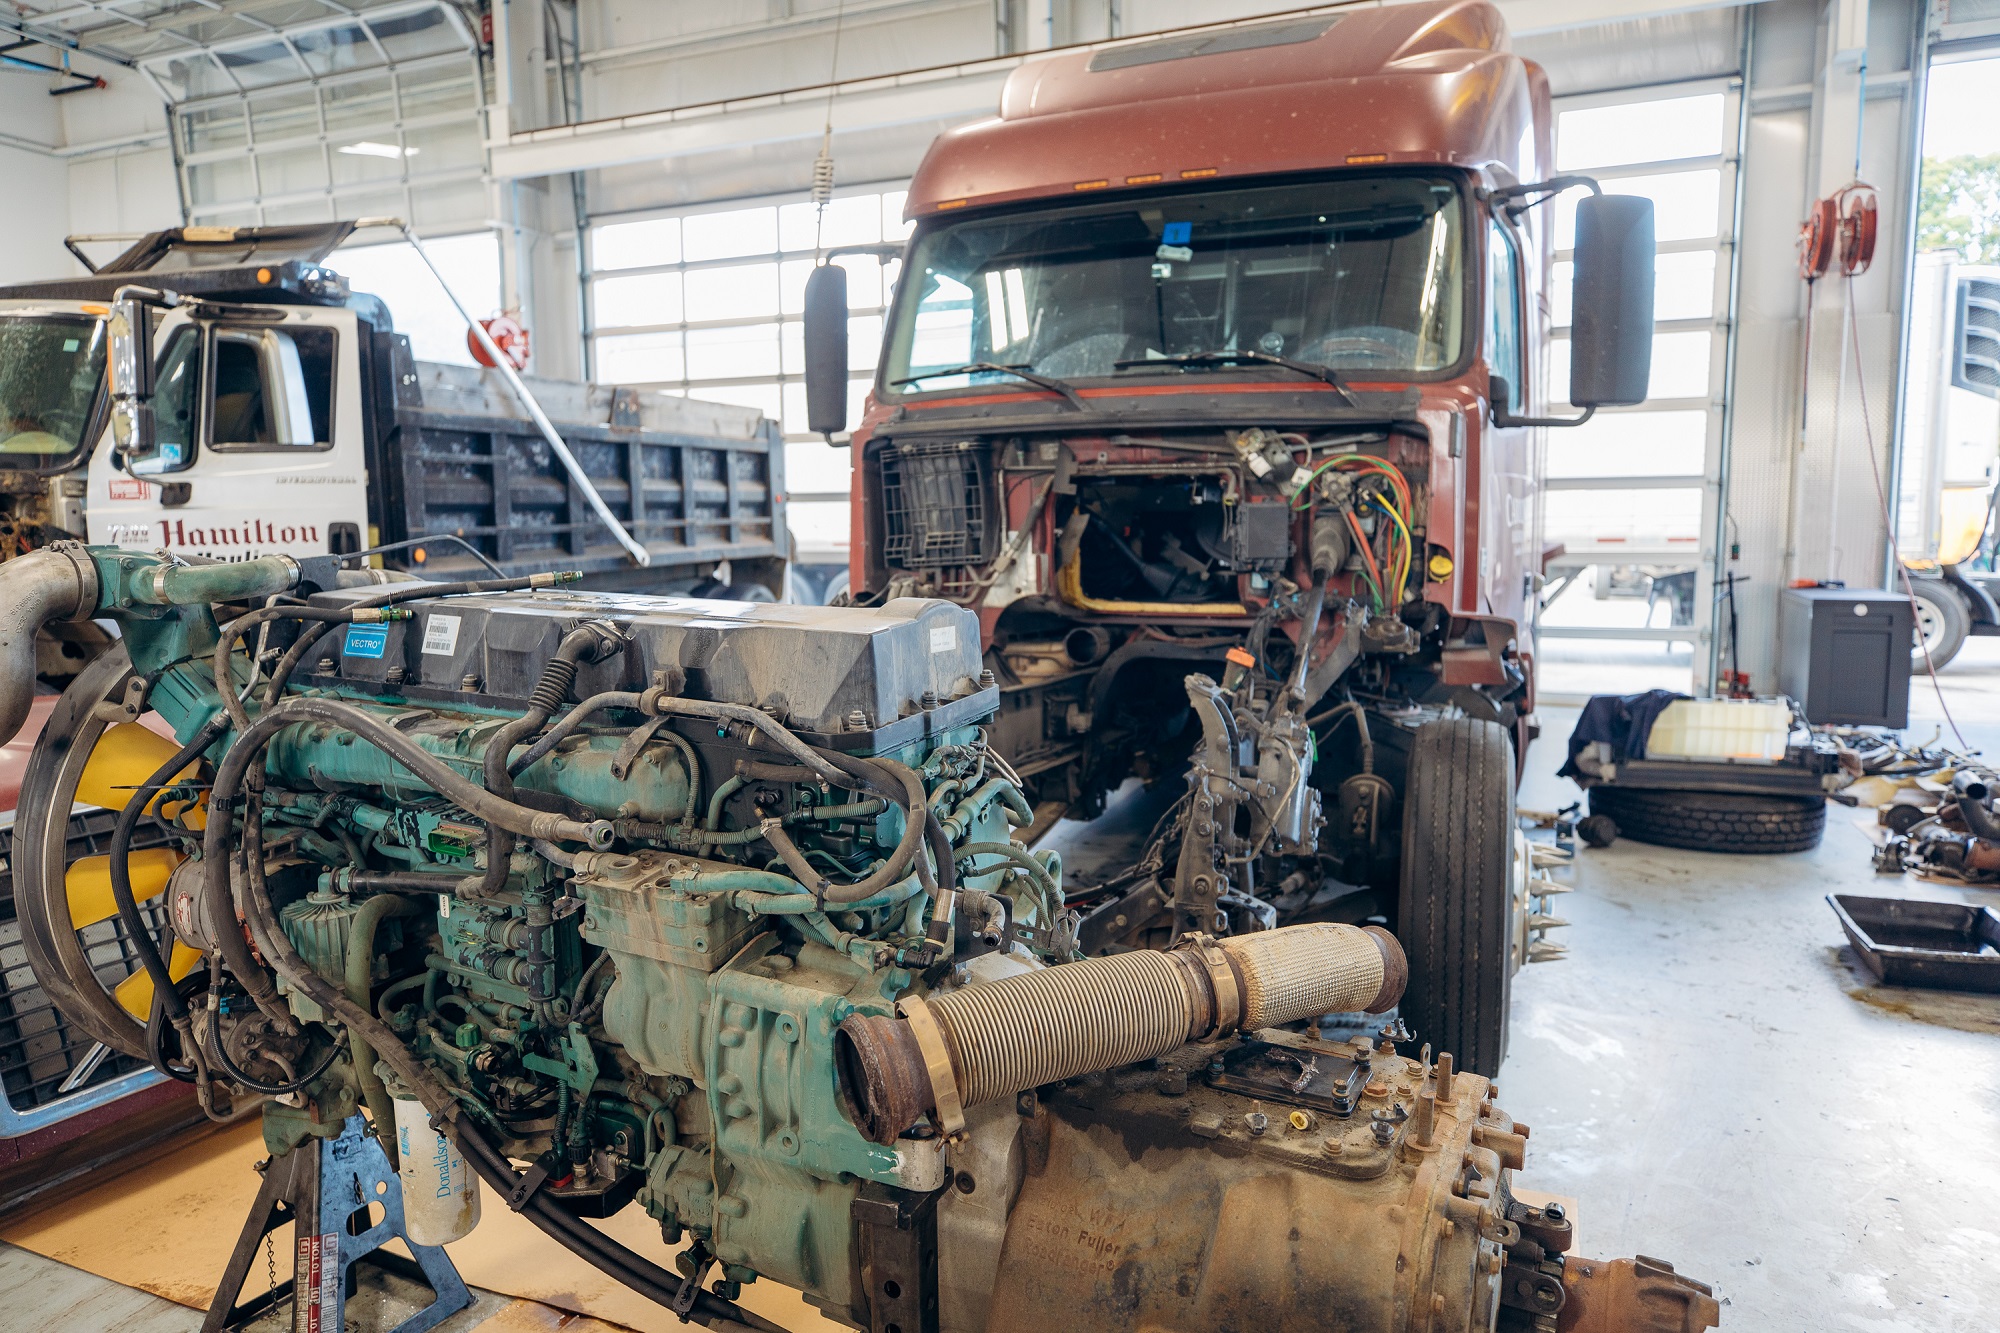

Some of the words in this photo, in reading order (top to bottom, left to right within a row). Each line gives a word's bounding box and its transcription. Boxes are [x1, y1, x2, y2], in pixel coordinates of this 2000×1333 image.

[155, 518, 320, 547] Hamilton
[433, 1135, 450, 1199] Donaldson
[1077, 1230, 1121, 1255] Fuller
